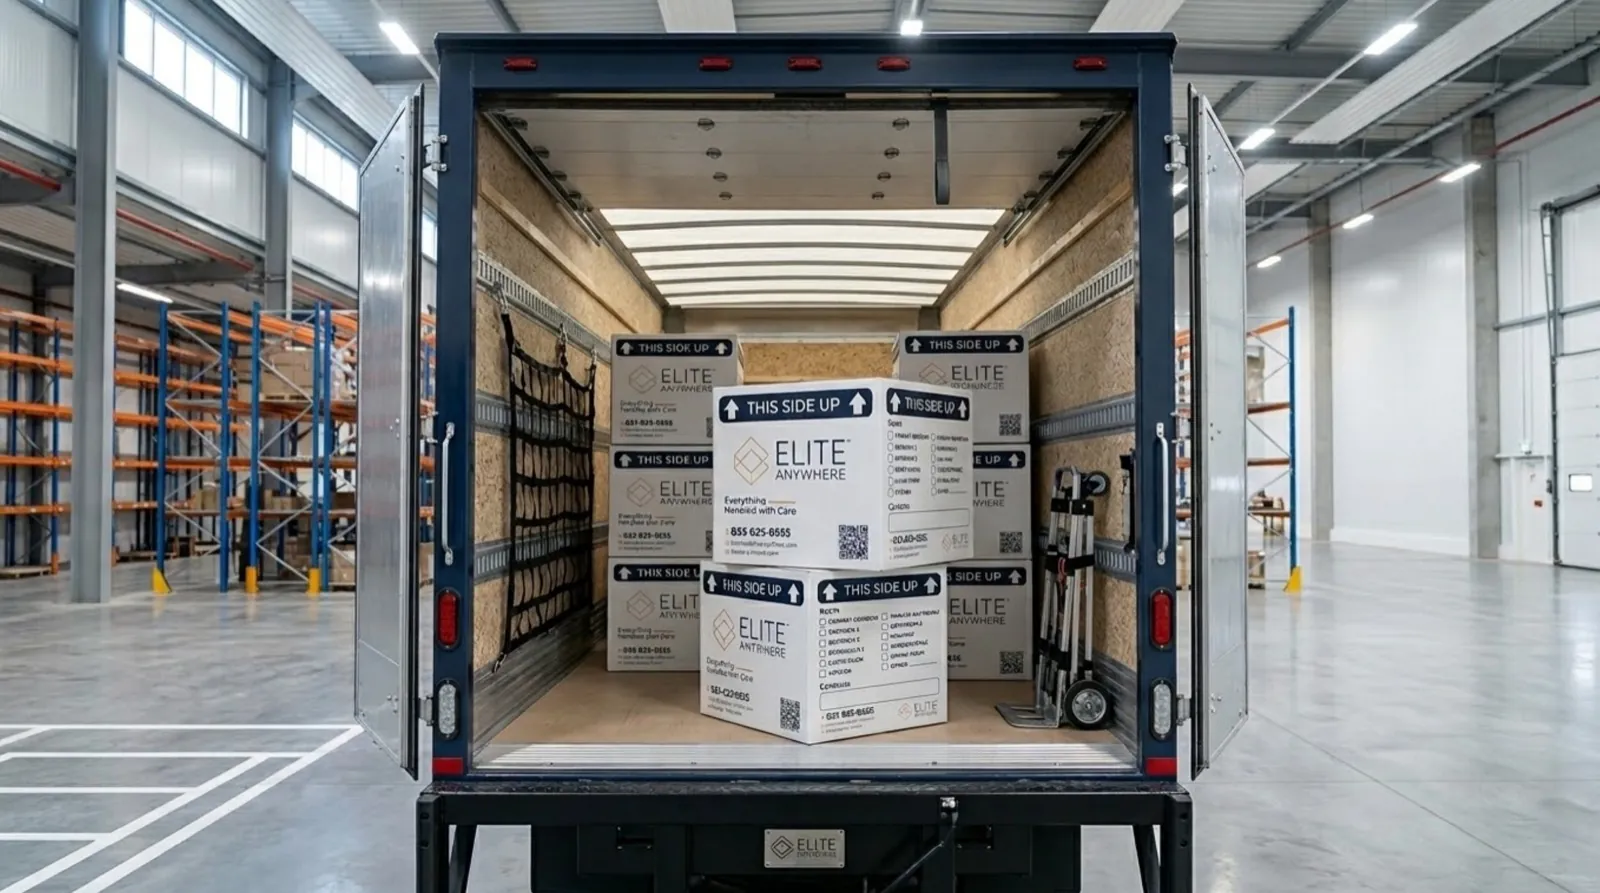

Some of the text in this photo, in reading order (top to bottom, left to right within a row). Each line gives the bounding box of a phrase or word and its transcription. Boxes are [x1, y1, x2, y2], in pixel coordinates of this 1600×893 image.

[638, 343, 663, 353] THIS
[694, 343, 709, 353] UP
[929, 340, 1000, 350] THIS SIDE UP
[661, 368, 712, 384] ELITE
[951, 365, 1004, 381] ELITE
[747, 397, 841, 415] THIS SIDE UP
[776, 439, 846, 466] ELITE
[985, 455, 1001, 464] UP
[637, 455, 709, 465] THIS SIDE UP
[775, 468, 846, 481] ANYWHERE
[660, 481, 713, 497] ELITE
[759, 506, 776, 515] with
[777, 506, 797, 516] Care
[955, 572, 982, 581] SIDE
[984, 572, 1001, 581] UP
[767, 584, 782, 597] UP
[844, 580, 918, 596] THIS SIDE UP
[660, 594, 699, 610] ELIT
[950, 598, 1006, 615] ELITE
[739, 616, 786, 645] ELITE
[797, 838, 836, 851] ELITE
